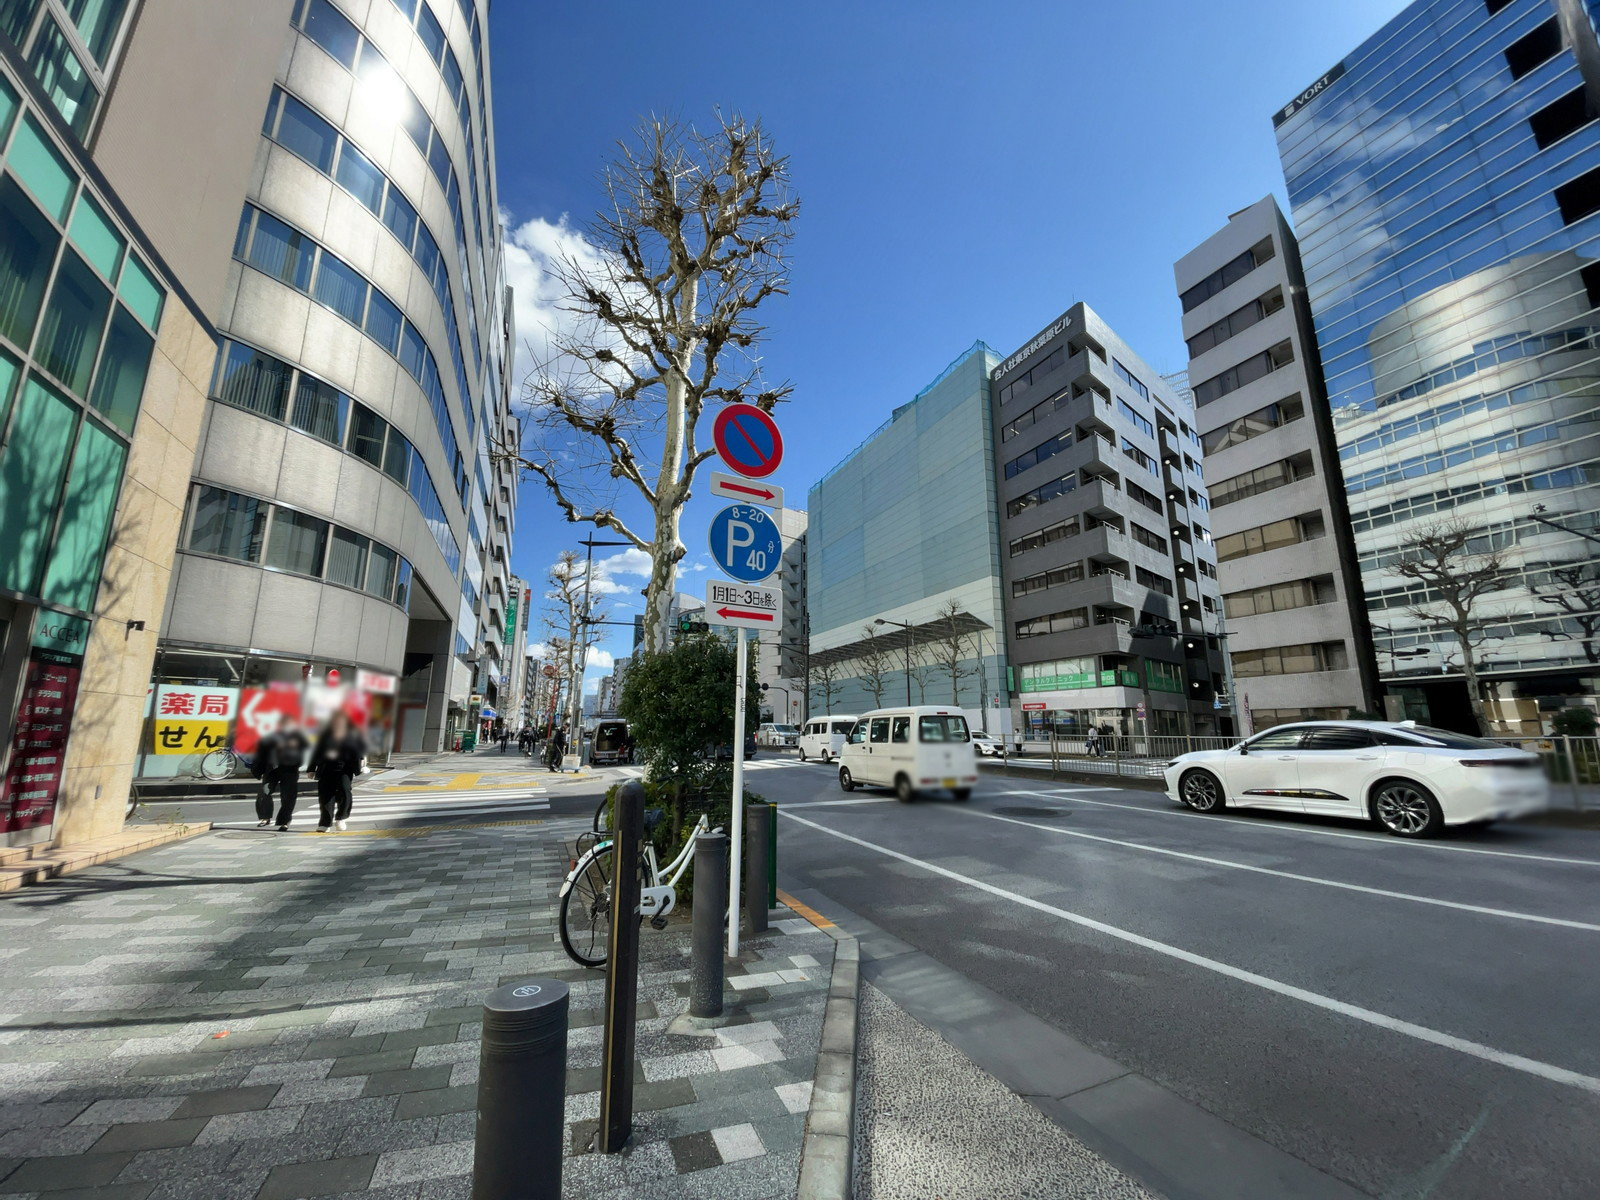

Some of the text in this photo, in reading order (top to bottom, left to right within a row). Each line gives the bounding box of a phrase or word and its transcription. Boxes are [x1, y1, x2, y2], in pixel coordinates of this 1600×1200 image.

[1296, 74, 1329, 105] VORT
[732, 507, 764, 523] 8-20
[727, 519, 755, 567] P
[40, 623, 81, 644] ACCEA
[160, 692, 229, 716] 薬局
[159, 726, 226, 748] せん
